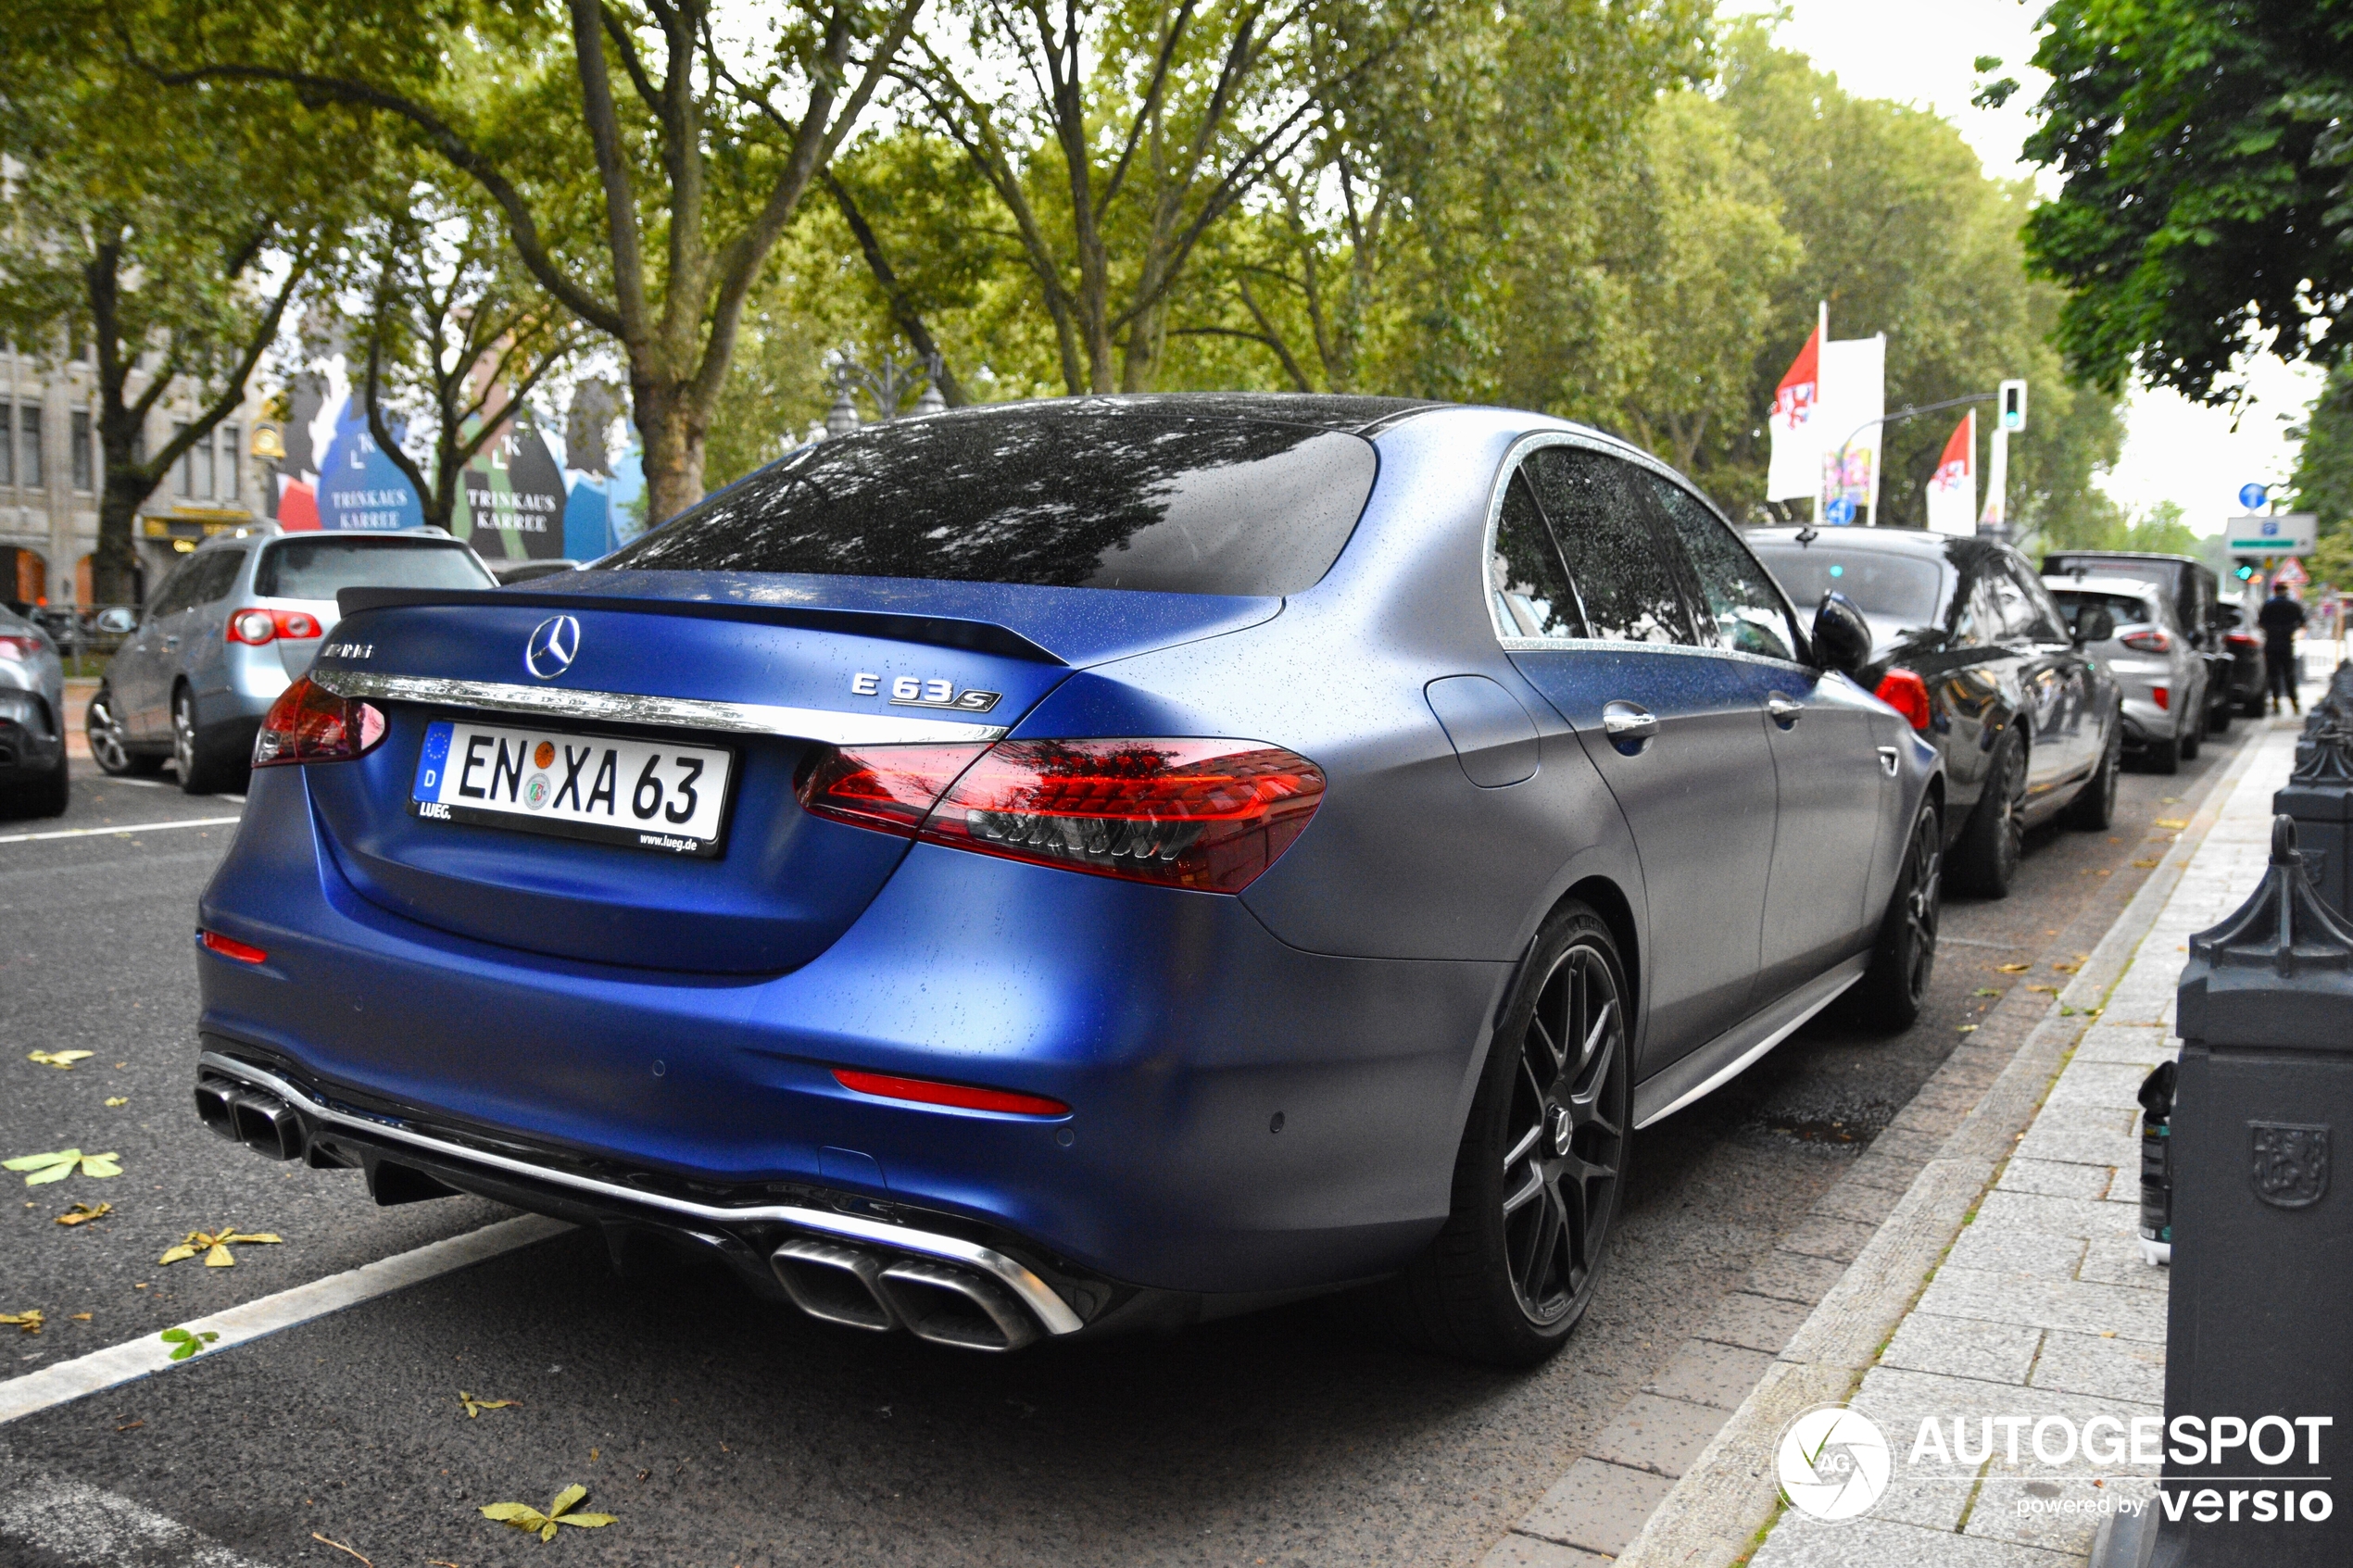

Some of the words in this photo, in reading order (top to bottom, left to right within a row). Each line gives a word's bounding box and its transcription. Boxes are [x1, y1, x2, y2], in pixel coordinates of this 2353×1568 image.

[331, 488, 408, 509] TRINKAUS
[466, 488, 556, 513] TRINKAUS
[339, 510, 400, 529] KARREE
[476, 510, 547, 533] KARREE
[851, 672, 881, 696] E
[892, 676, 953, 702] 63
[423, 770, 436, 787] D
[459, 734, 528, 803] EN
[553, 745, 618, 815] XA
[632, 754, 704, 824] 63
[640, 834, 698, 851] www.lueg.de
